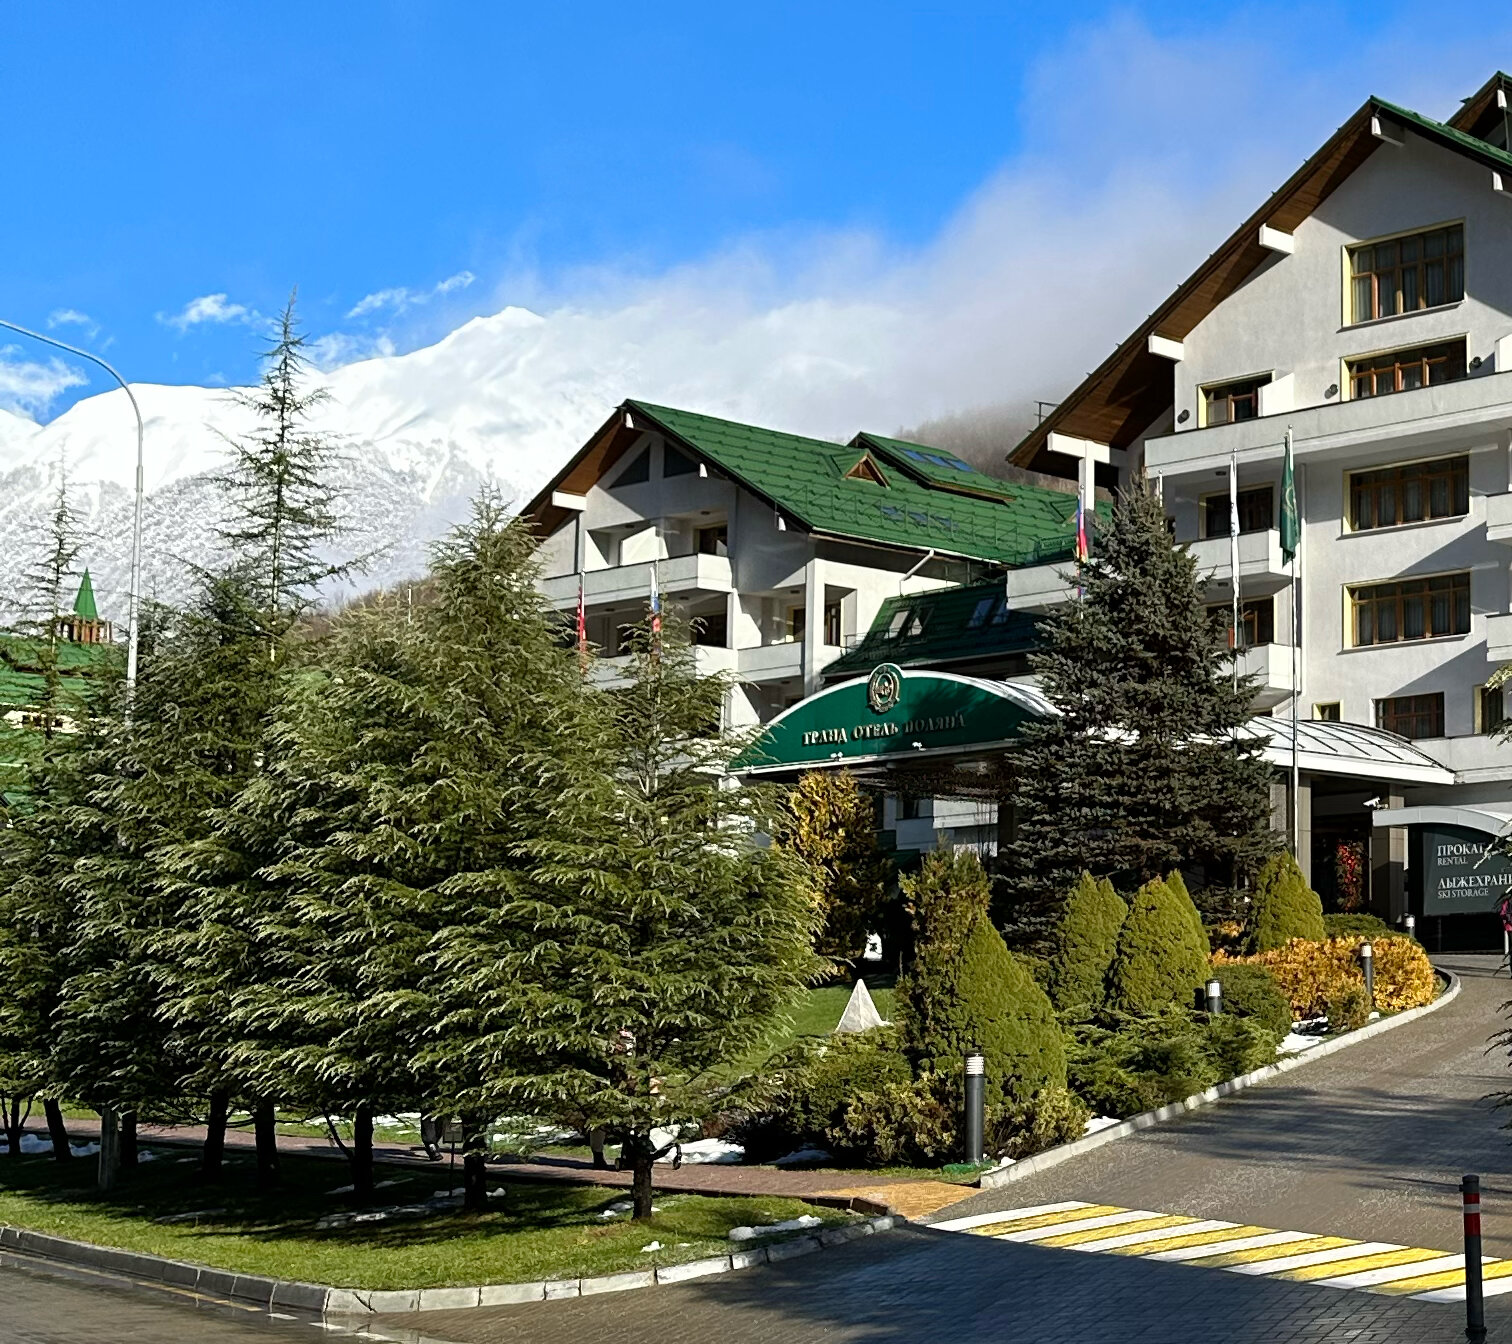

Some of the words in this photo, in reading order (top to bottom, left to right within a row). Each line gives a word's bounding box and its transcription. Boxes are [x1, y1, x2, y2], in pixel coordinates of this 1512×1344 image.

[803, 727, 848, 745] ГРАНД
[853, 722, 899, 739] ОТЕЛЬ
[905, 713, 966, 733] ПОЛЯНА
[1437, 843, 1486, 857] ПРОКАТ
[1437, 856, 1468, 866] RENTAL
[1437, 889, 1451, 899] SKI
[1452, 887, 1489, 897] STORAGE
